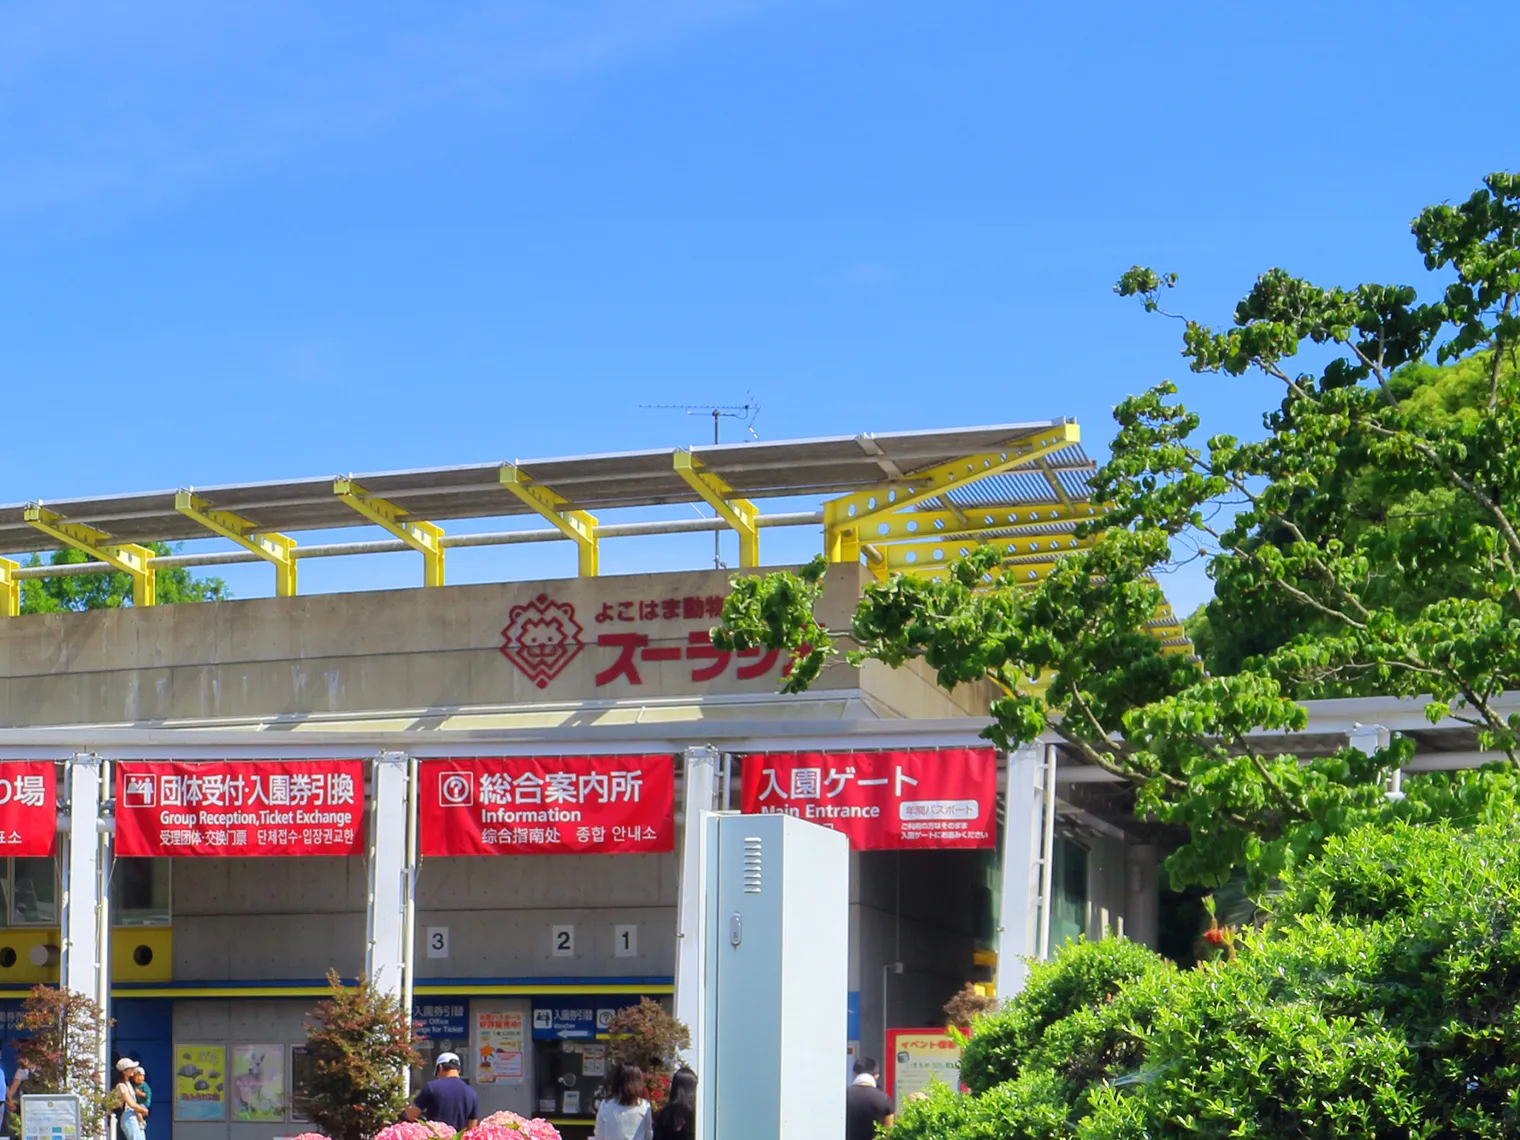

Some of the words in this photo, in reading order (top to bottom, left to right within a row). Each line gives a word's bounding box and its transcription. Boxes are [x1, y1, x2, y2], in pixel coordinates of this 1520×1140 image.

[595, 595, 724, 623] よこはま動物
[160, 773, 355, 806] 団体受付・入園券引換
[479, 770, 643, 805] 総合案内所
[759, 766, 918, 801] 入園ゲート
[160, 810, 197, 827] Group
[296, 810, 352, 827] Exchange
[481, 807, 582, 823] Information
[805, 804, 881, 818] Entrance
[481, 828, 561, 845] 综合指南处
[576, 826, 606, 842] 종합
[612, 825, 657, 842] 안내소
[432, 933, 445, 950] 3
[557, 931, 571, 950] 2
[622, 931, 629, 950] 1
